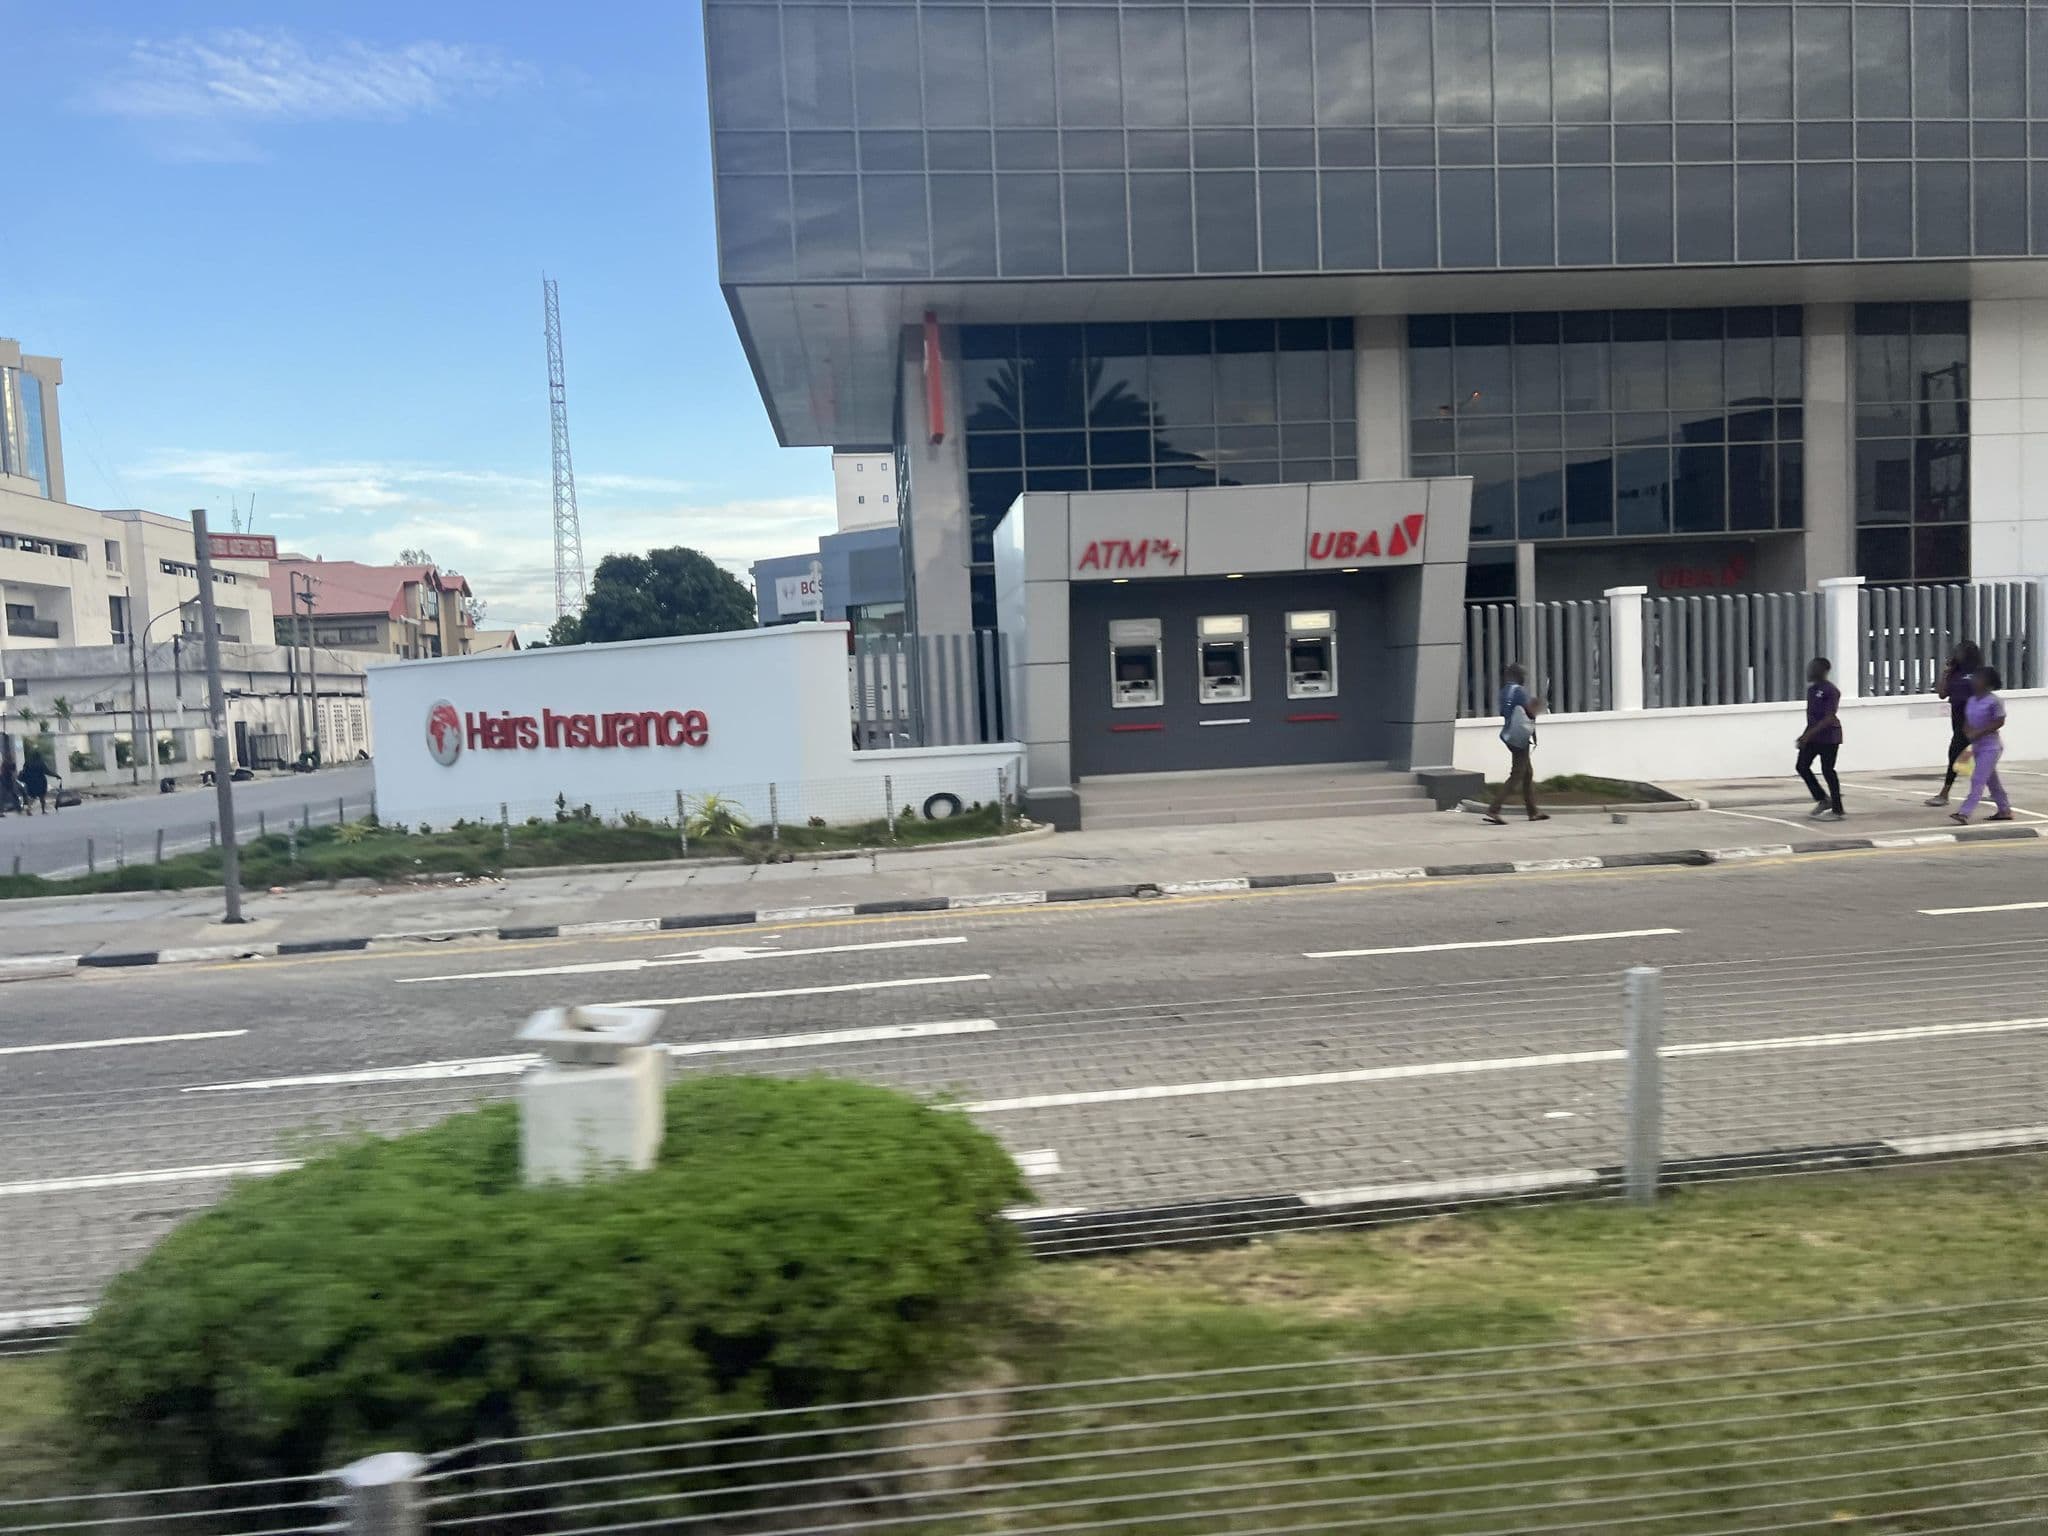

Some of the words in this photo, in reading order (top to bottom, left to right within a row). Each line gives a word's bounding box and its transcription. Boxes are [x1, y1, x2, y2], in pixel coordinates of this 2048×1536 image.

[1078, 540, 1149, 571] ATM
[1309, 530, 1381, 560] UBA
[465, 710, 538, 750] Heirs
[542, 708, 709, 749] Insurance
